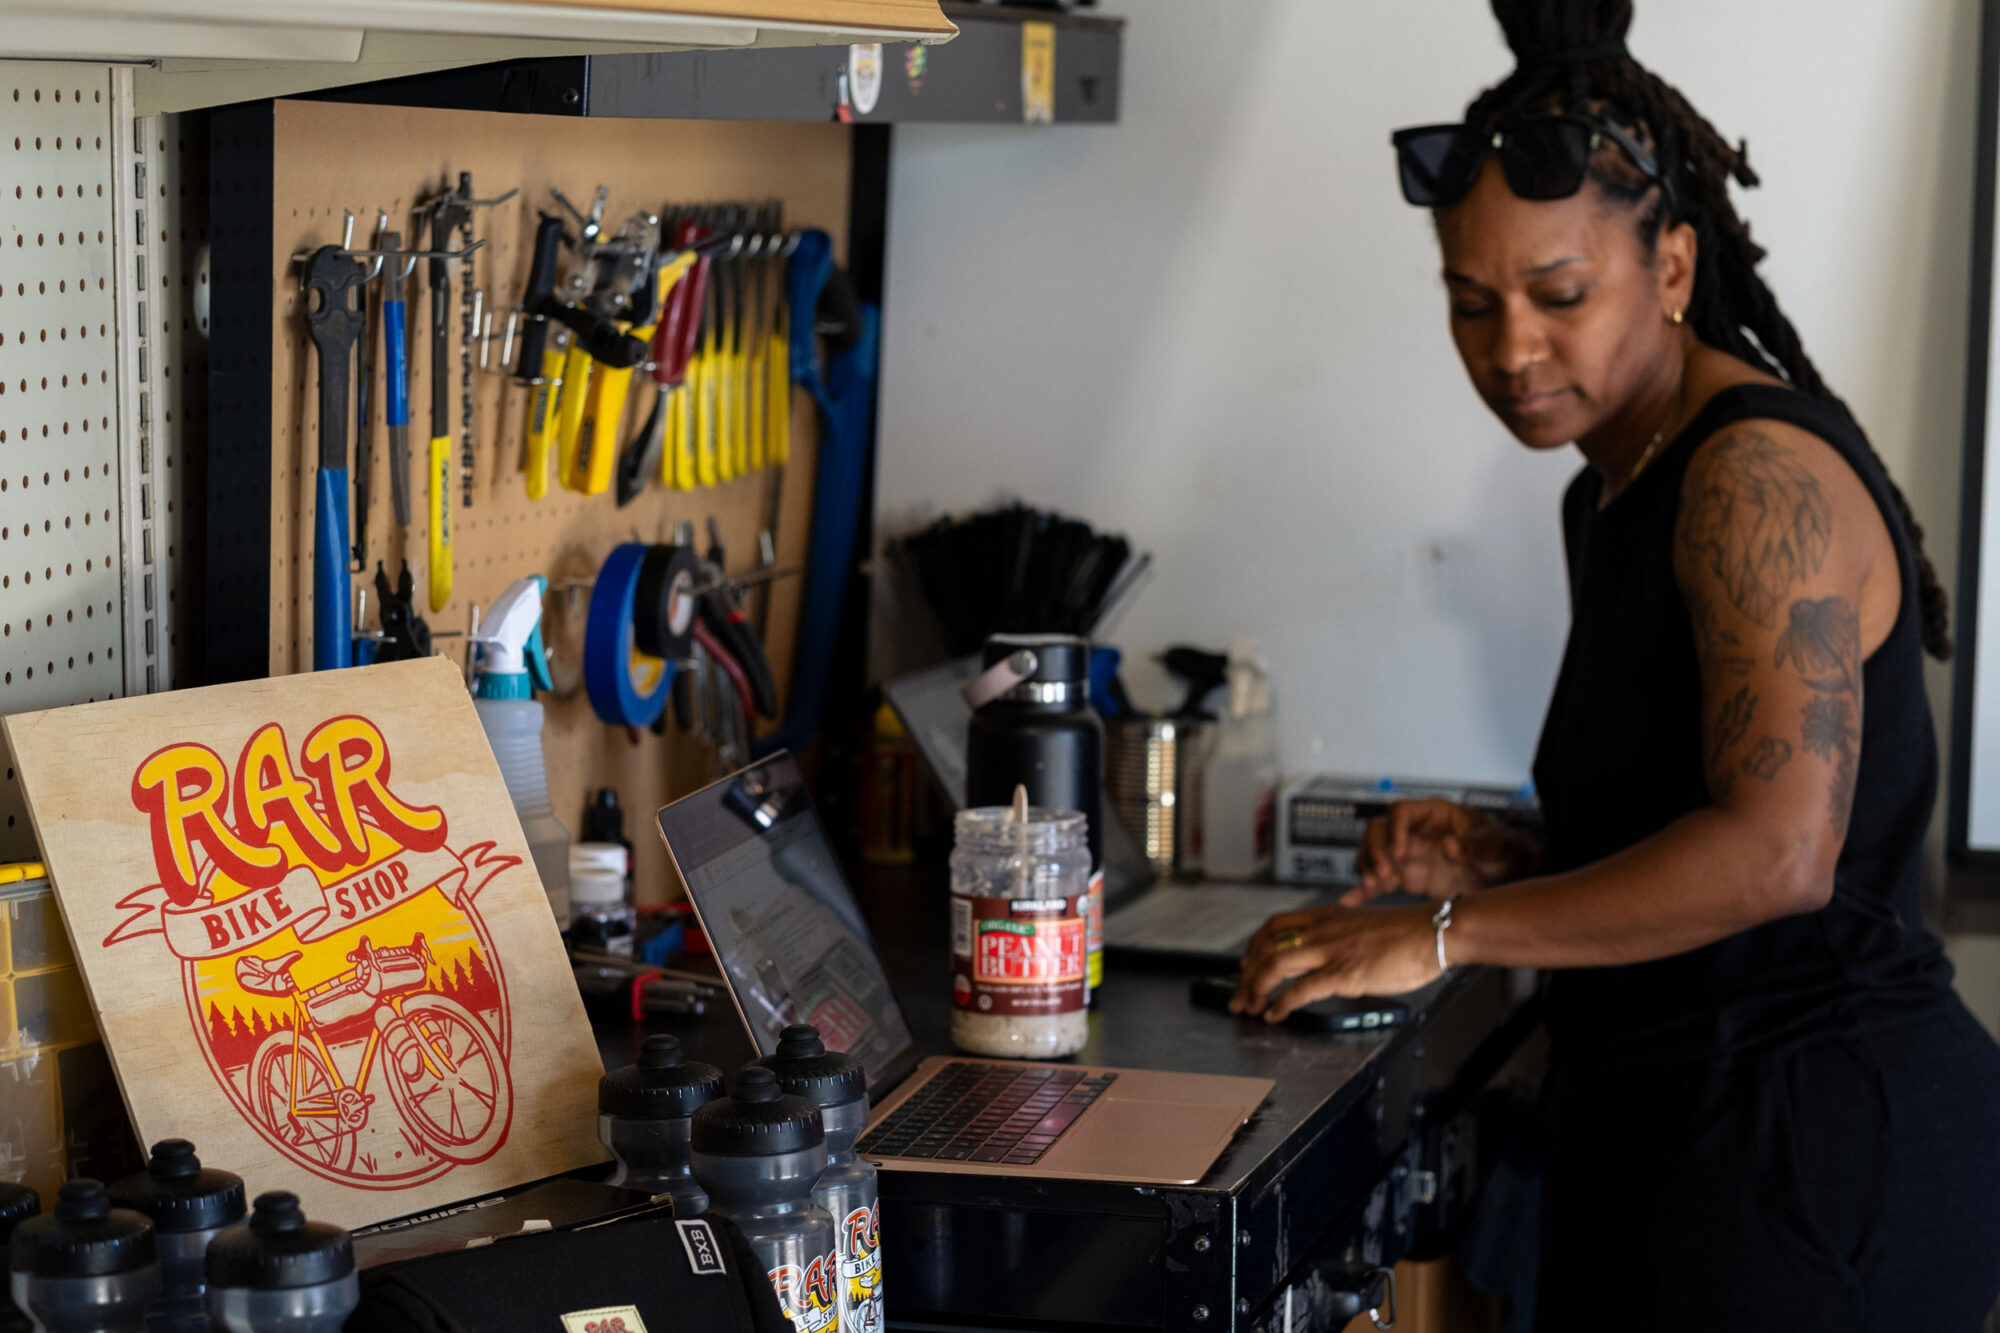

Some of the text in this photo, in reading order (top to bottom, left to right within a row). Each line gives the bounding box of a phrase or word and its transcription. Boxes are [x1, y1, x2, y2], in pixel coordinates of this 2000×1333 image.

[132, 714, 448, 906] RAR
[200, 861, 409, 949] BIKE SHOP
[981, 935, 1080, 957] PEANUT
[981, 956, 1080, 977] BUTTER
[690, 1229, 715, 1266] BXB
[854, 1254, 876, 1275] BIKE
